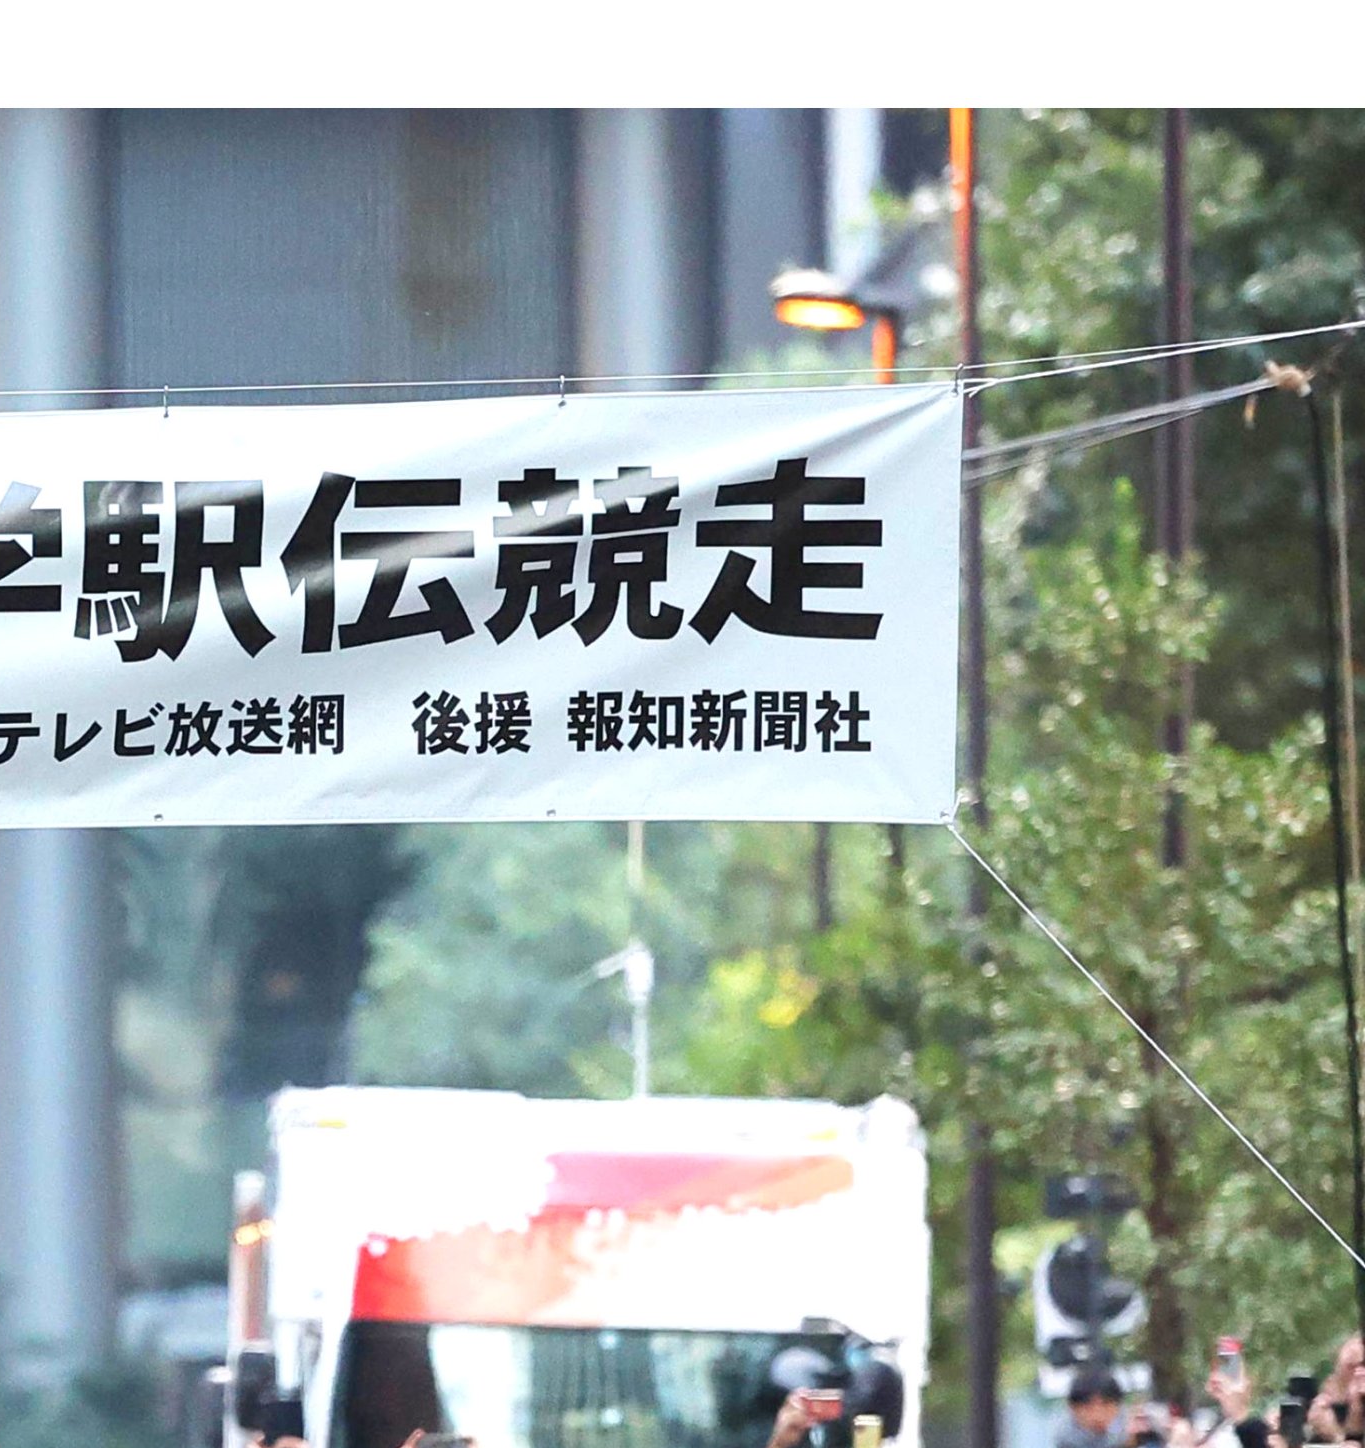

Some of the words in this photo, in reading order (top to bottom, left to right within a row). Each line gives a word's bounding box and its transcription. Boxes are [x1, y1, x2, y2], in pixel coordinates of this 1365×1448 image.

[412, 689, 532, 754] 後援
[566, 688, 872, 754] 報知新聞社
